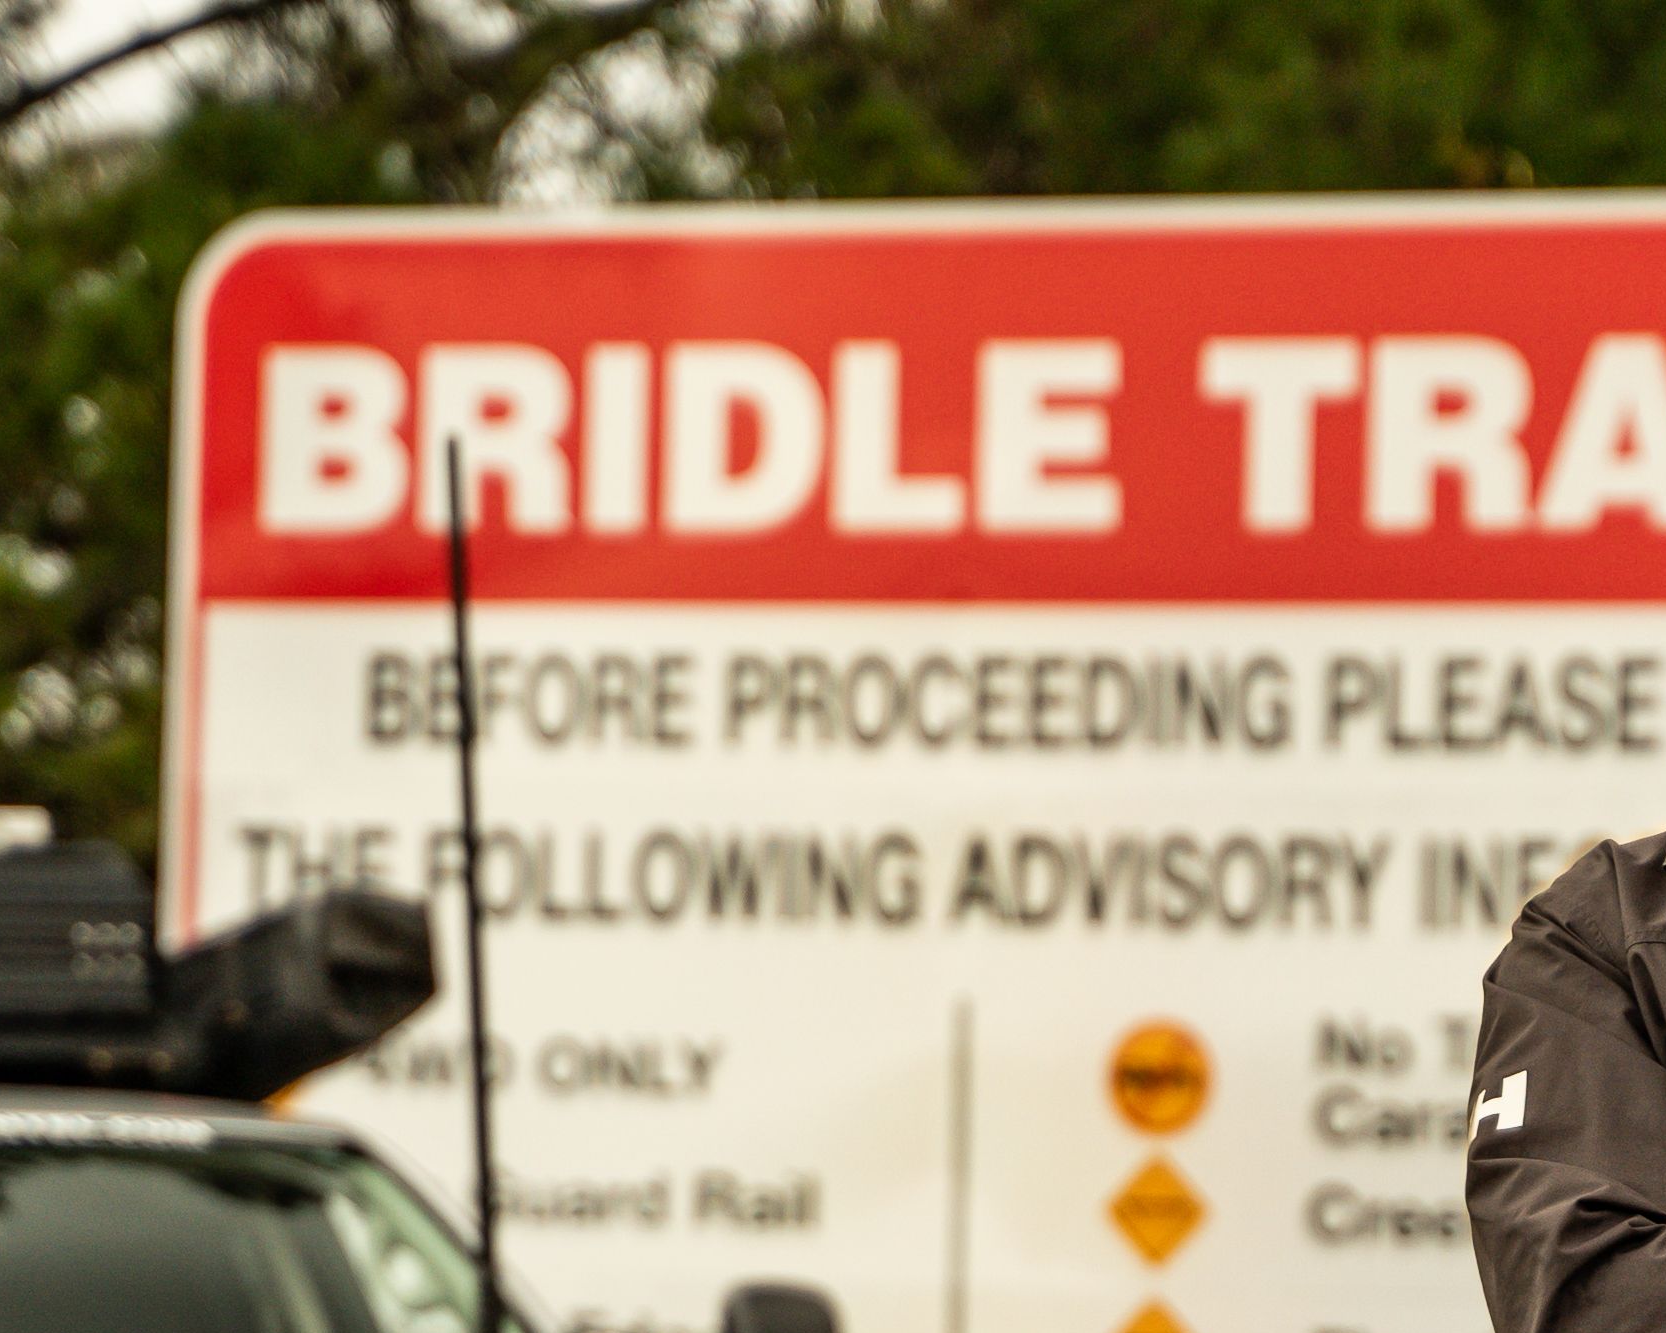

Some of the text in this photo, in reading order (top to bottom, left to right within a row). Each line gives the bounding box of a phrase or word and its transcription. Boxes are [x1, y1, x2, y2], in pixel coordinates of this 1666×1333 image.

[259, 340, 1122, 535] BRIDLE
[363, 650, 693, 748] BEFORE
[722, 651, 1294, 754] PROCEEDING
[1321, 653, 1664, 755] PLEASE
[426, 822, 926, 928] FOLLOWING
[946, 831, 1391, 935] ADVISORY
[1418, 837, 1598, 930] INF
[534, 1033, 724, 1100] ONLY
[1312, 1012, 1416, 1075] No
[690, 1168, 824, 1230] Rail
